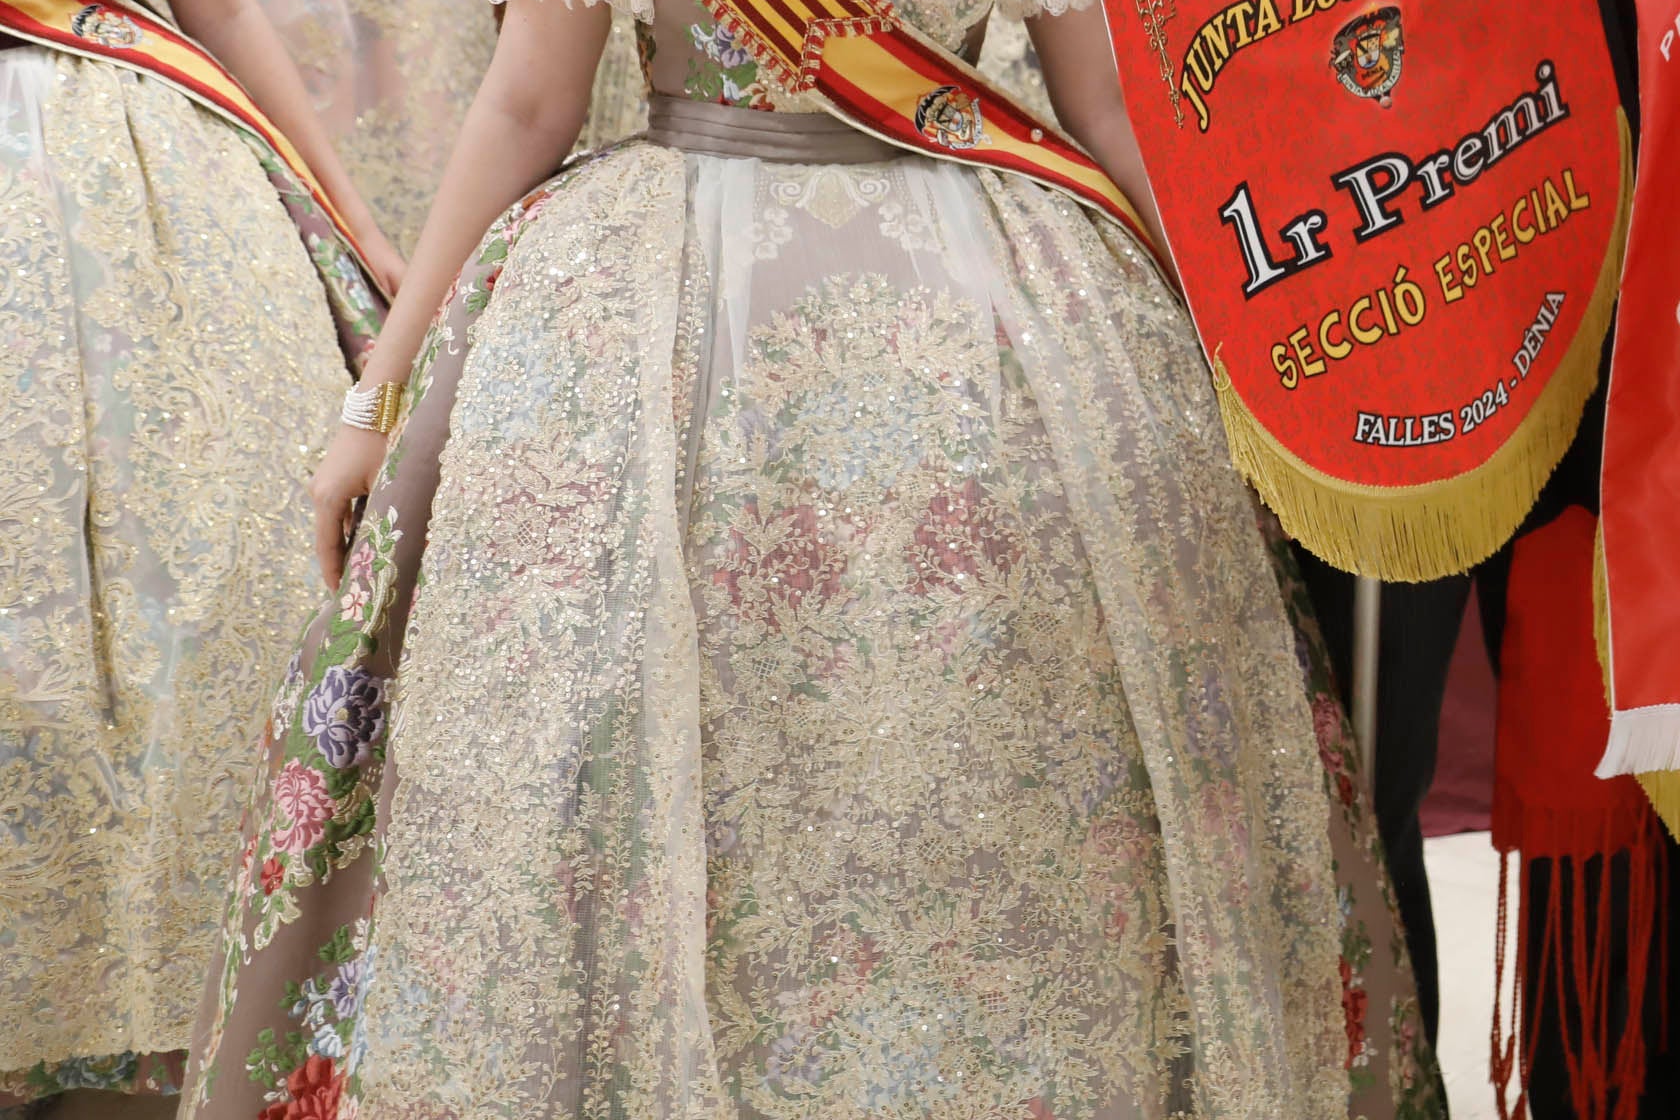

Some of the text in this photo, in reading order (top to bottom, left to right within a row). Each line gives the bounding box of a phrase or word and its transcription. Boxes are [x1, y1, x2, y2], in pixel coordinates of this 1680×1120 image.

[1219, 59, 1570, 301] 1r Premi
[1270, 167, 1591, 390] SECCIÓ ESPECIAL
[1352, 410, 1456, 446] FALLES
[1459, 381, 1509, 436] 2024
[1511, 290, 1566, 381] DÉNIA
